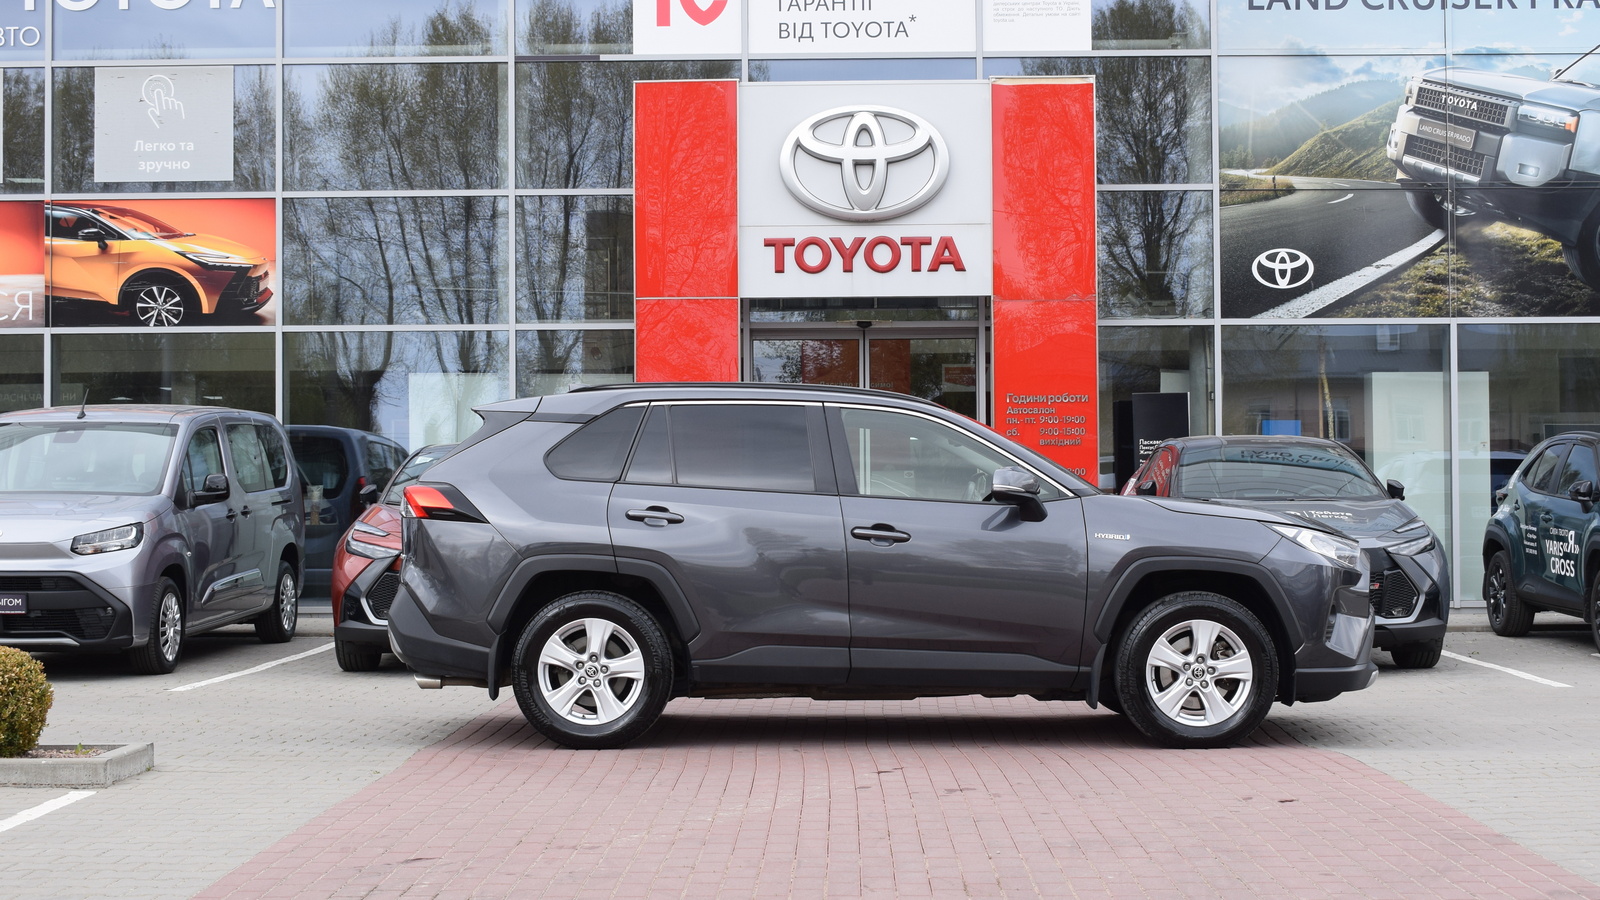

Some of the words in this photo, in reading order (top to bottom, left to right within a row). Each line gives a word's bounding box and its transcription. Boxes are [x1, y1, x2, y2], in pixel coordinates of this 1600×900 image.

[778, 22, 815, 42] ВІД
[1441, 95, 1478, 111] TOYOTA
[1419, 124, 1433, 134] LAND
[1432, 127, 1454, 138] CRUISER
[1453, 132, 1471, 143] PRADO
[134, 140, 176, 152] Легко
[179, 142, 195, 151] та
[138, 160, 191, 173] зручно
[763, 236, 967, 274] TOYOTA
[1006, 393, 1047, 404] Години
[1047, 392, 1089, 405] роботи
[1006, 406, 1056, 414] Автосалон
[1006, 428, 1020, 436] сб.
[1039, 427, 1086, 436] 9:00-15:00
[1039, 437, 1082, 446] вихідний
[1545, 539, 1564, 557] YARIS
[1550, 557, 1576, 578] CROSS
